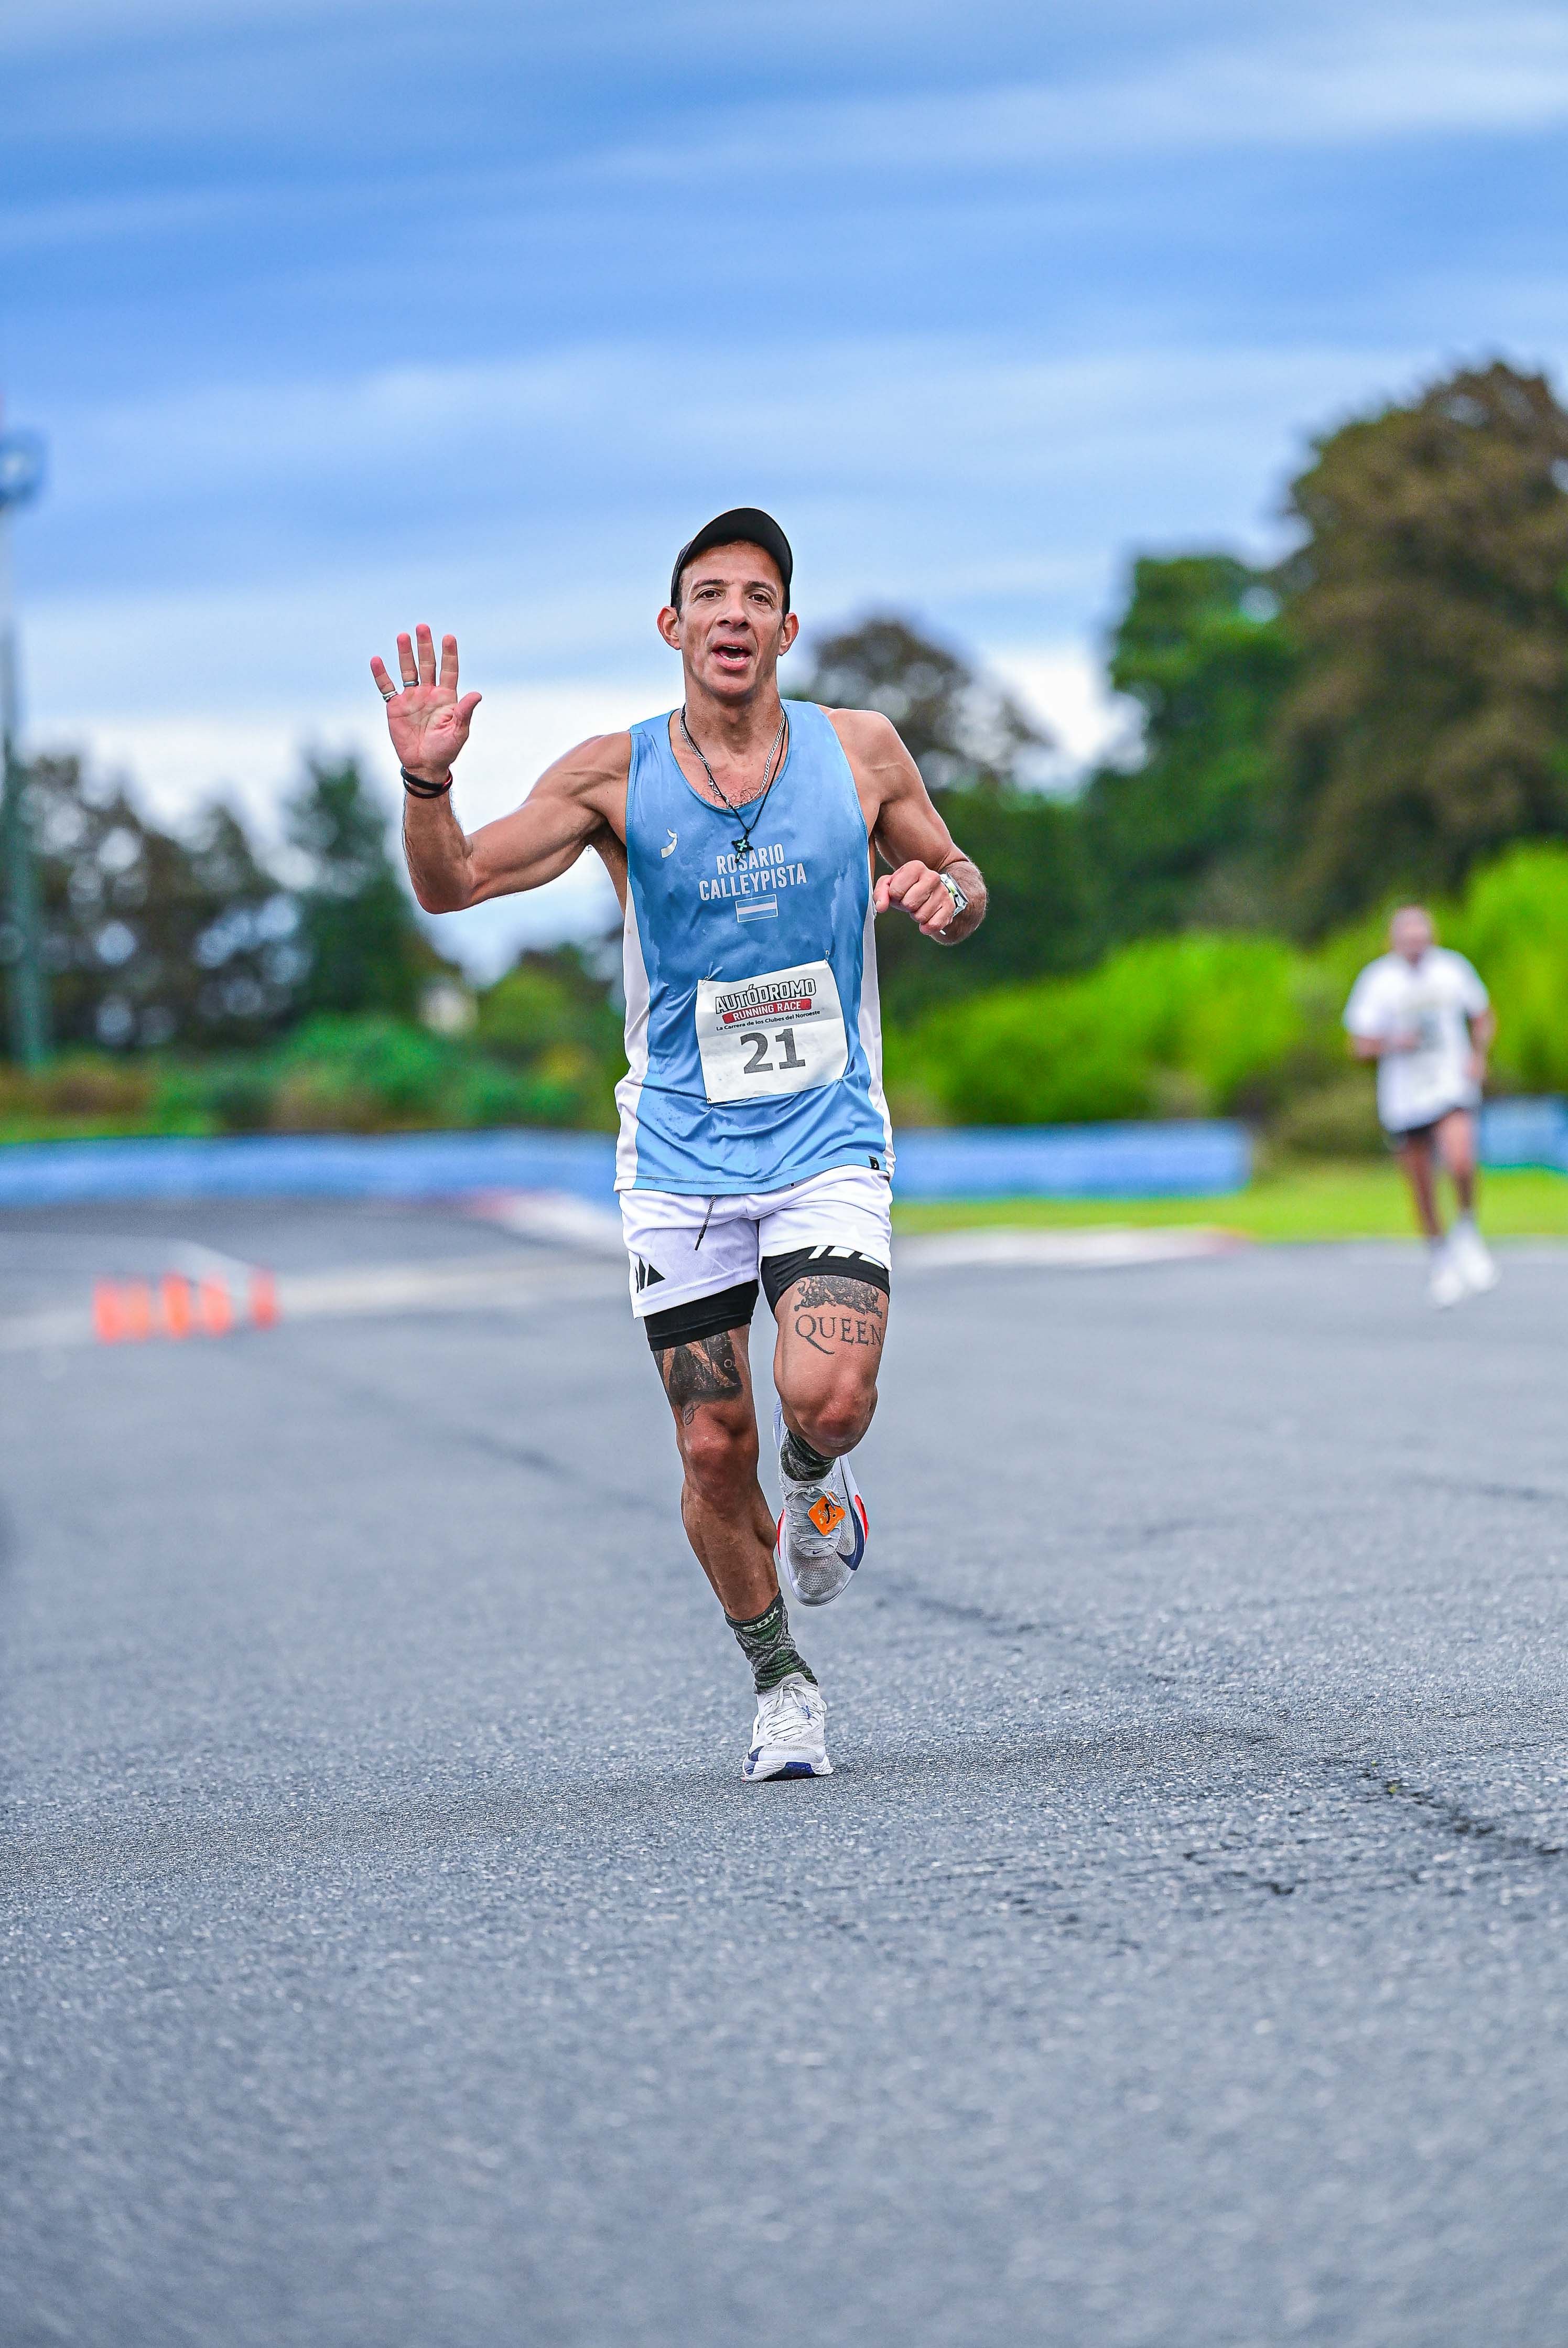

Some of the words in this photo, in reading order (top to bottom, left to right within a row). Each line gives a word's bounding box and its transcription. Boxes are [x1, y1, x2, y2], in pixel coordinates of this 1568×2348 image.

[716, 844, 785, 875] ROSARIO
[699, 863, 807, 901] CALLEYPISTA
[716, 978, 816, 1014] AUTÓDROMO
[732, 1004, 774, 1021] RUNNING
[777, 1001, 802, 1011] RACE
[740, 1028, 806, 1074] 21
[795, 1315, 882, 1354] QUEEN
[743, 1606, 780, 1632] SOX
